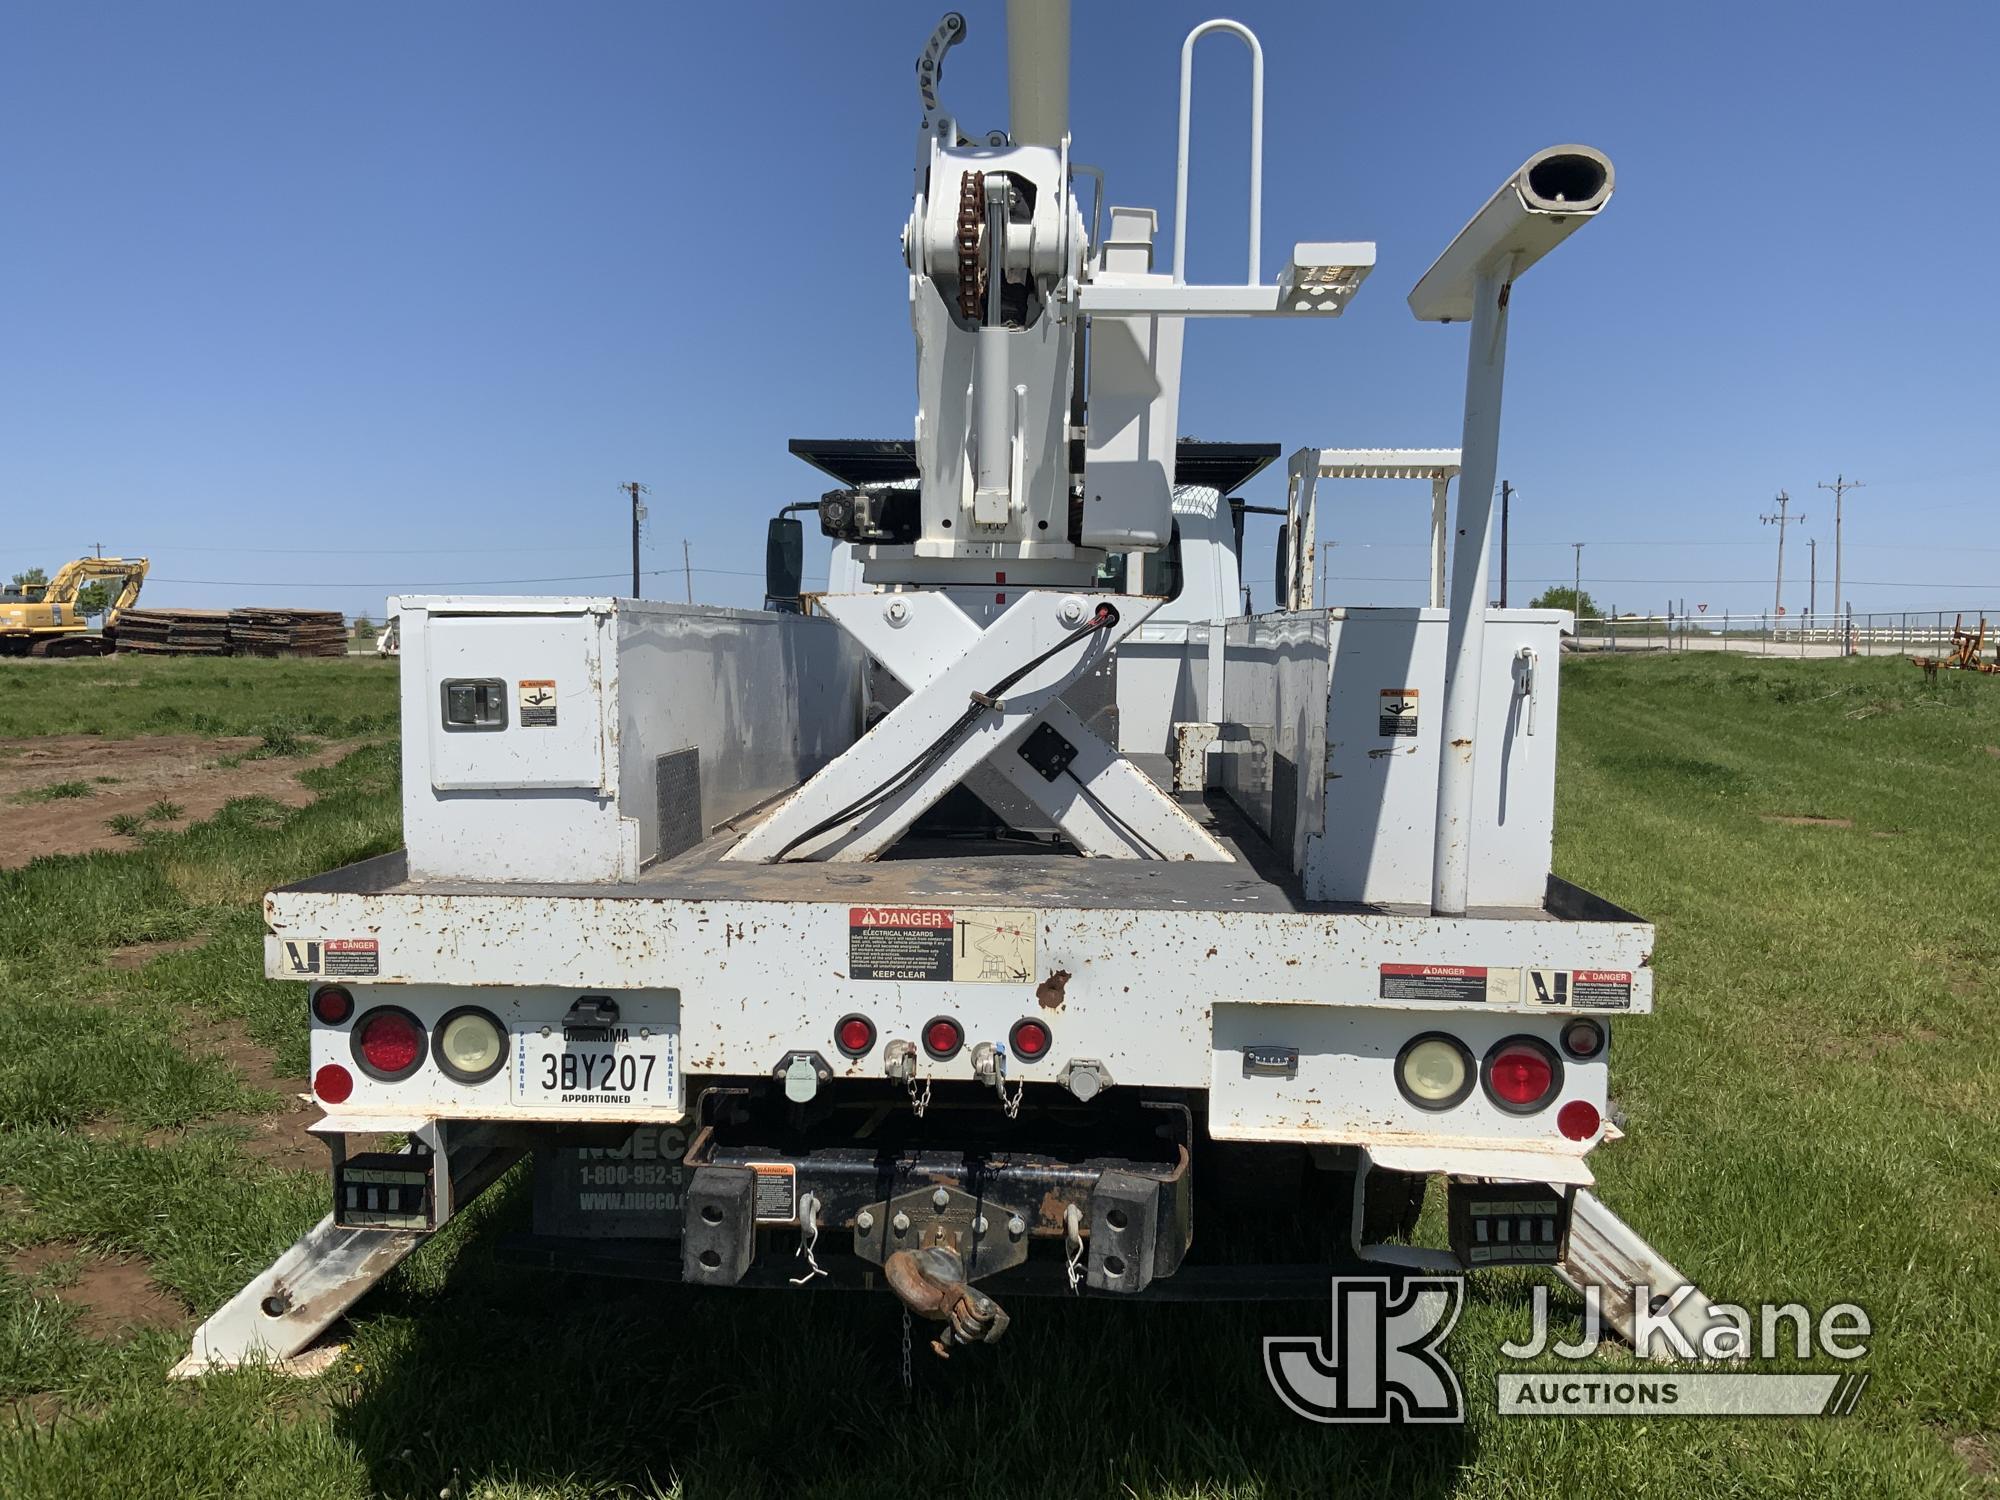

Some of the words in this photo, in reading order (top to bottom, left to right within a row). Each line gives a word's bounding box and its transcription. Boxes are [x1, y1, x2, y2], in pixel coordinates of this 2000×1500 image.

[879, 912, 942, 926] DANGER
[872, 970, 895, 978] KEEP
[897, 970, 926, 979] CLEAR
[563, 1028, 629, 1042] OOMA
[518, 1031, 526, 1097] PERMANENT
[666, 1033, 674, 1099] PERMANENT
[541, 1053, 656, 1092] 3BY207
[561, 1094, 631, 1104] APPORTIONED
